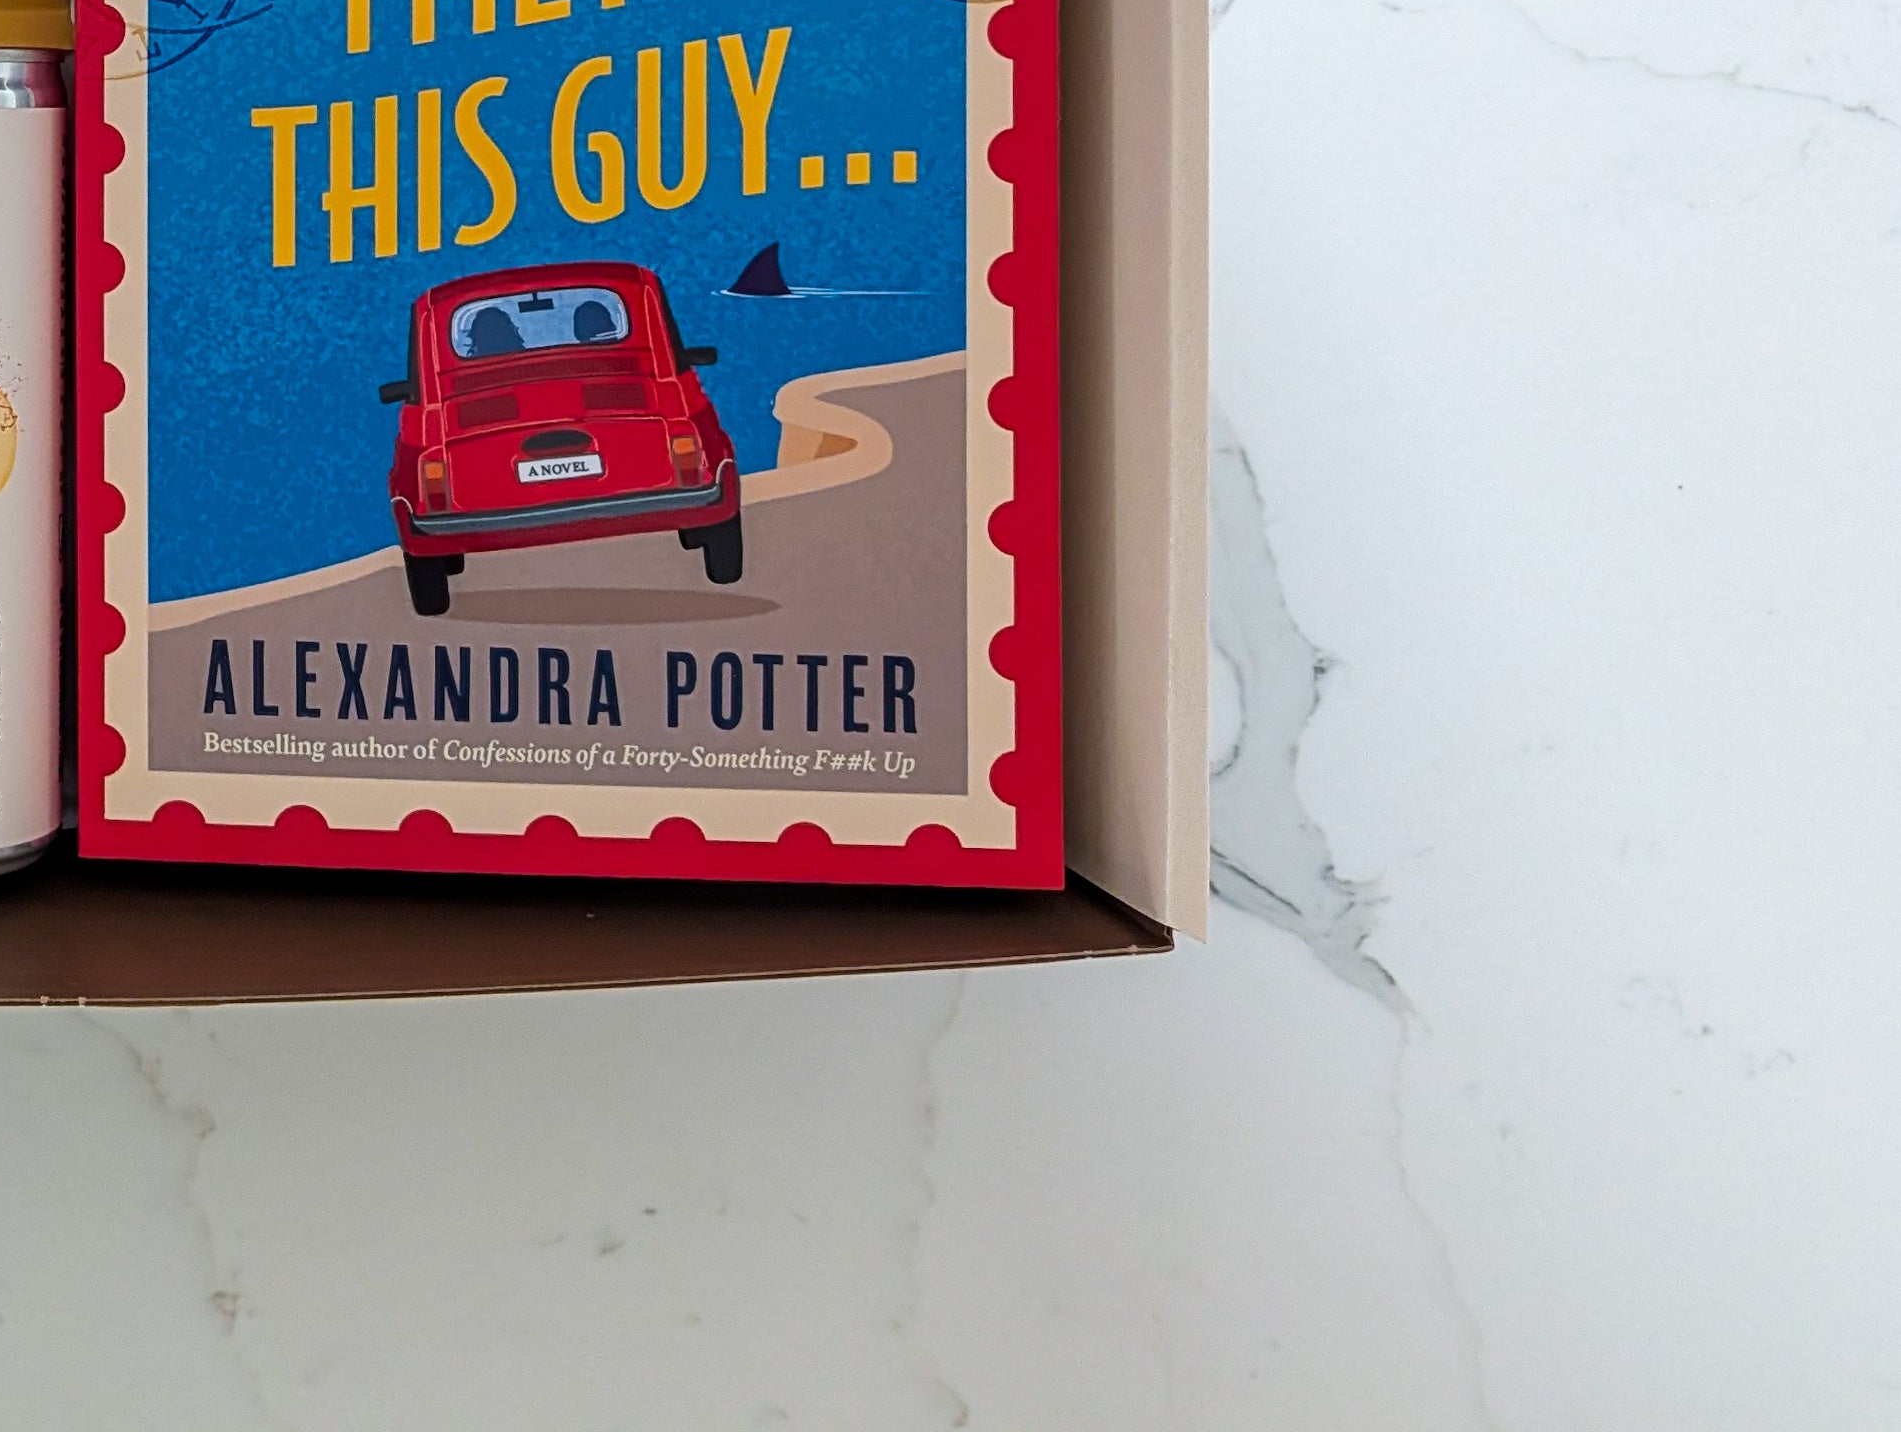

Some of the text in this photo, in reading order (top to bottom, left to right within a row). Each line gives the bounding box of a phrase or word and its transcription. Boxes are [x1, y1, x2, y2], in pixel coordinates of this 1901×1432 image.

[250, 26, 919, 269] THIS GUY...
[528, 461, 590, 477] A NOVEL
[202, 638, 919, 735] ALEXANDRA POTTER
[203, 731, 916, 778] Bestselling author of Confessions of a Forty-Something F##k Up
